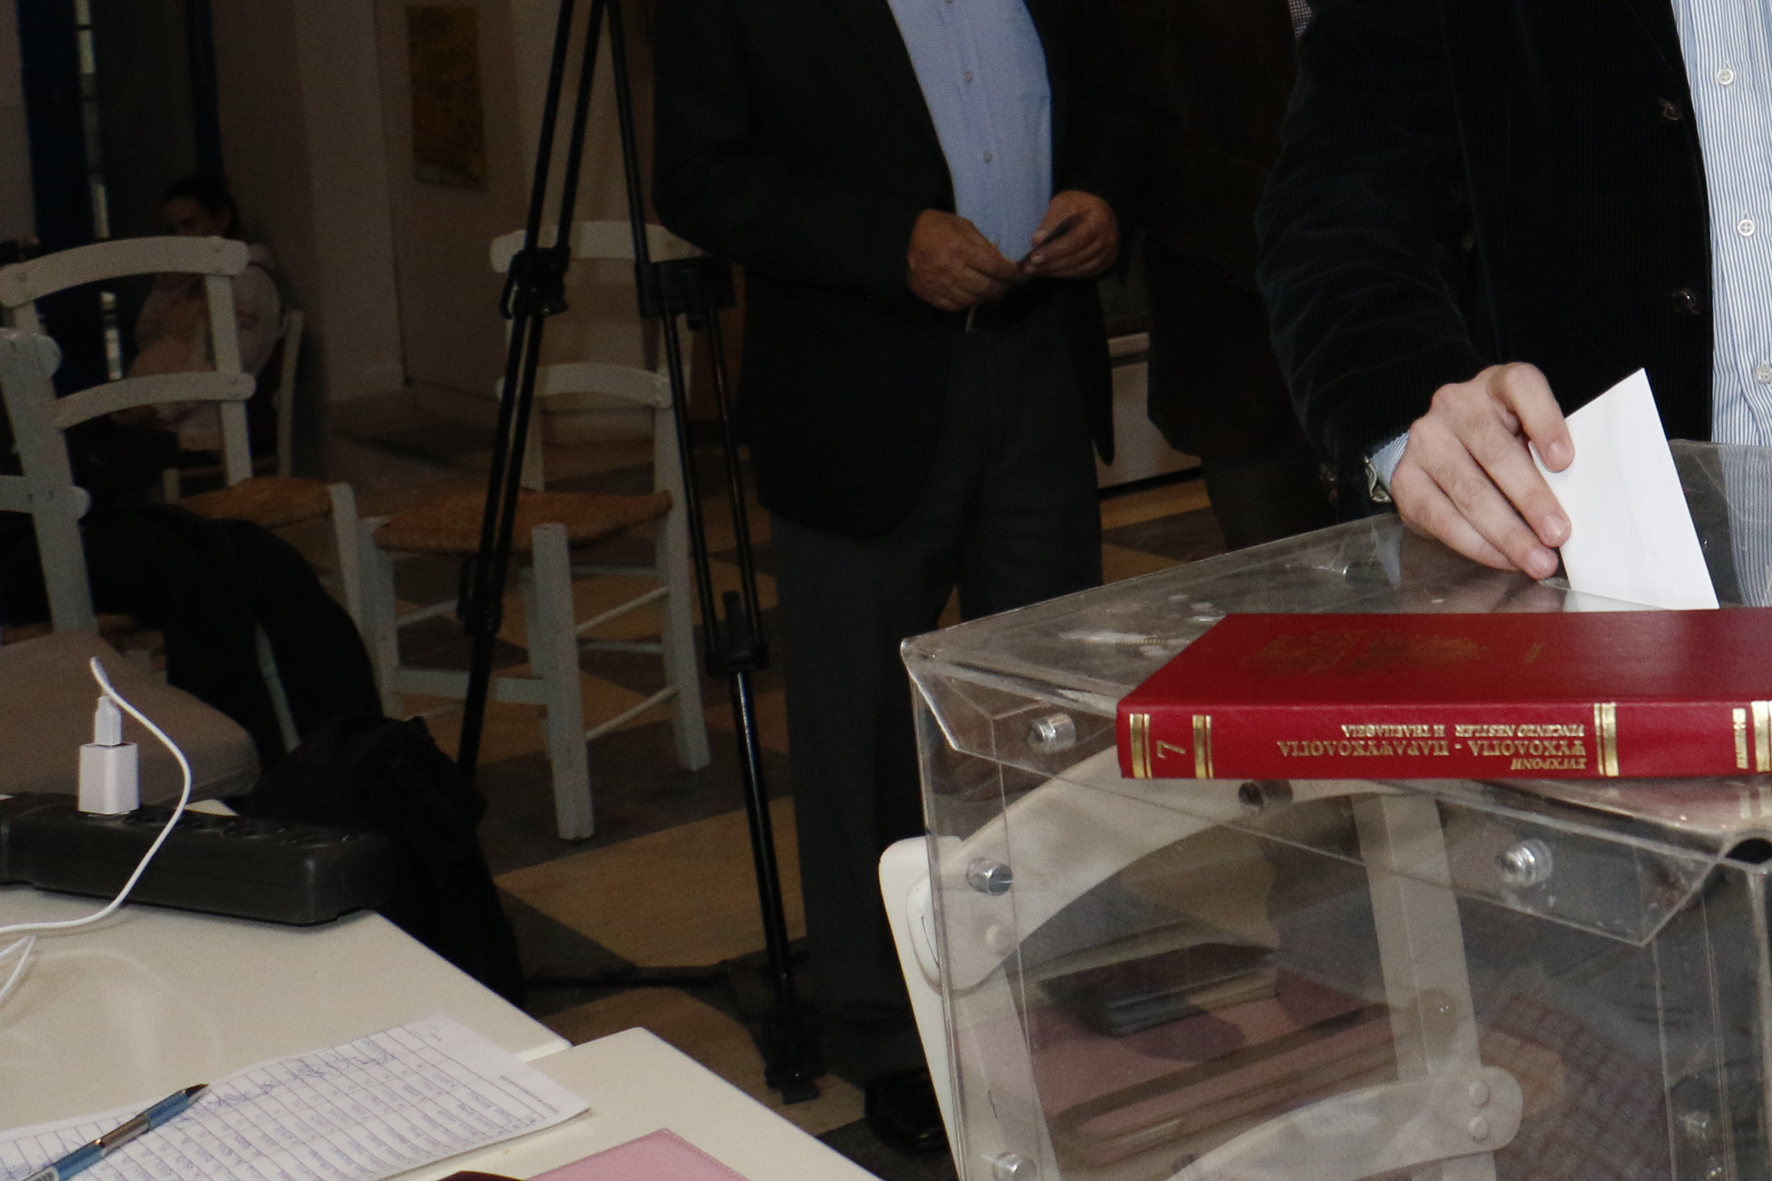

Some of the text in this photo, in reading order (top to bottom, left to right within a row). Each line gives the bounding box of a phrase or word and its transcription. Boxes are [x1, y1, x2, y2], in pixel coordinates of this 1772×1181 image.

[1340, 723, 1430, 737] ΤΗΛΕΠΑΘΕΙΑ
[1155, 738, 1187, 760] 7
[1276, 739, 1450, 757] ΠΑΡΑΨΥΧΟΛΟΓΙΑ
[1467, 739, 1587, 757] ΨΥΧΟΛΟΓΙΑ
